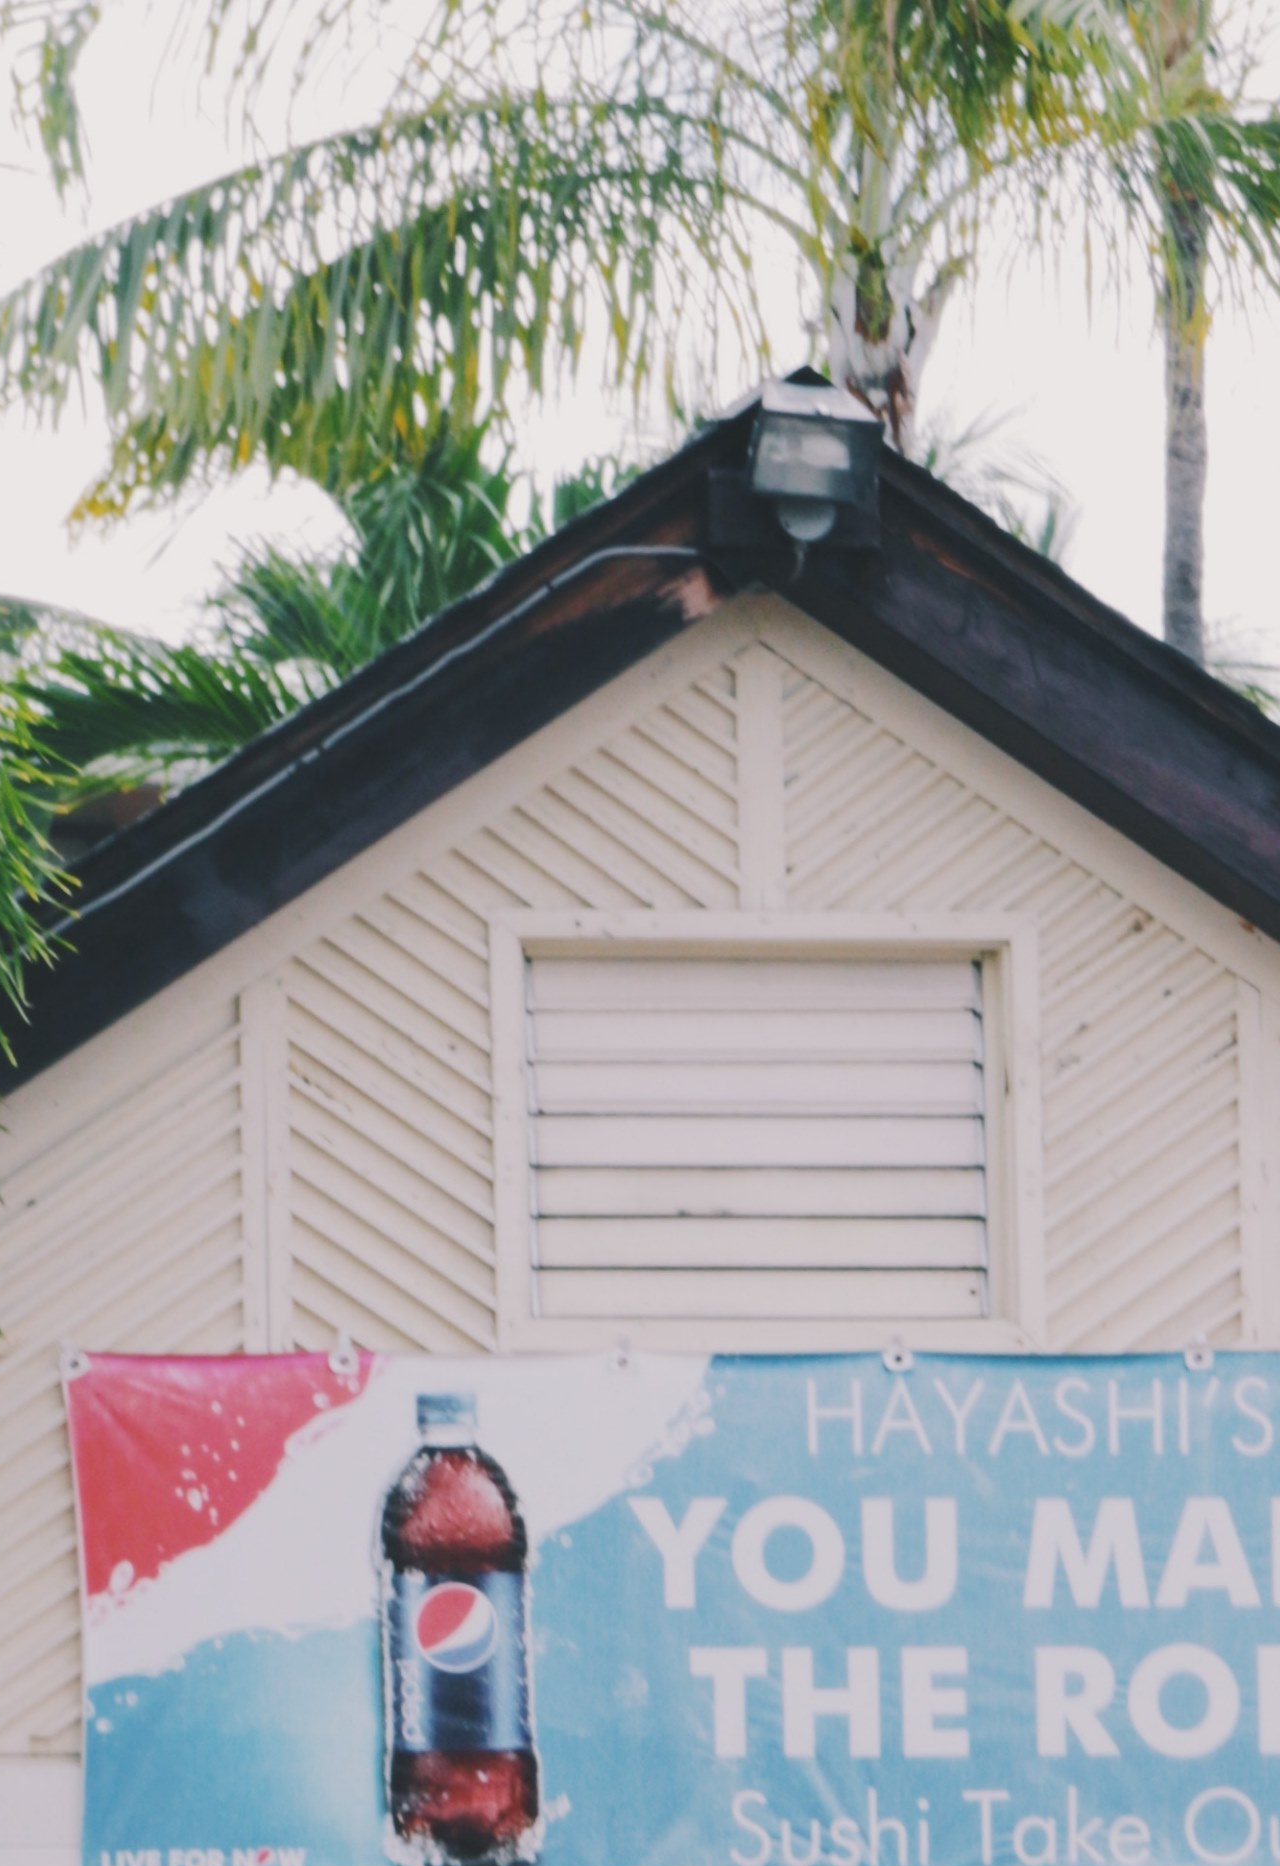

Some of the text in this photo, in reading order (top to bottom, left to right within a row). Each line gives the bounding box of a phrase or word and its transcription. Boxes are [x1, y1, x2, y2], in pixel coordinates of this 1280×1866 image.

[805, 1376, 1277, 1458] HAYASHI'S
[627, 1494, 960, 1613] YOU
[688, 1645, 971, 1760] THE
